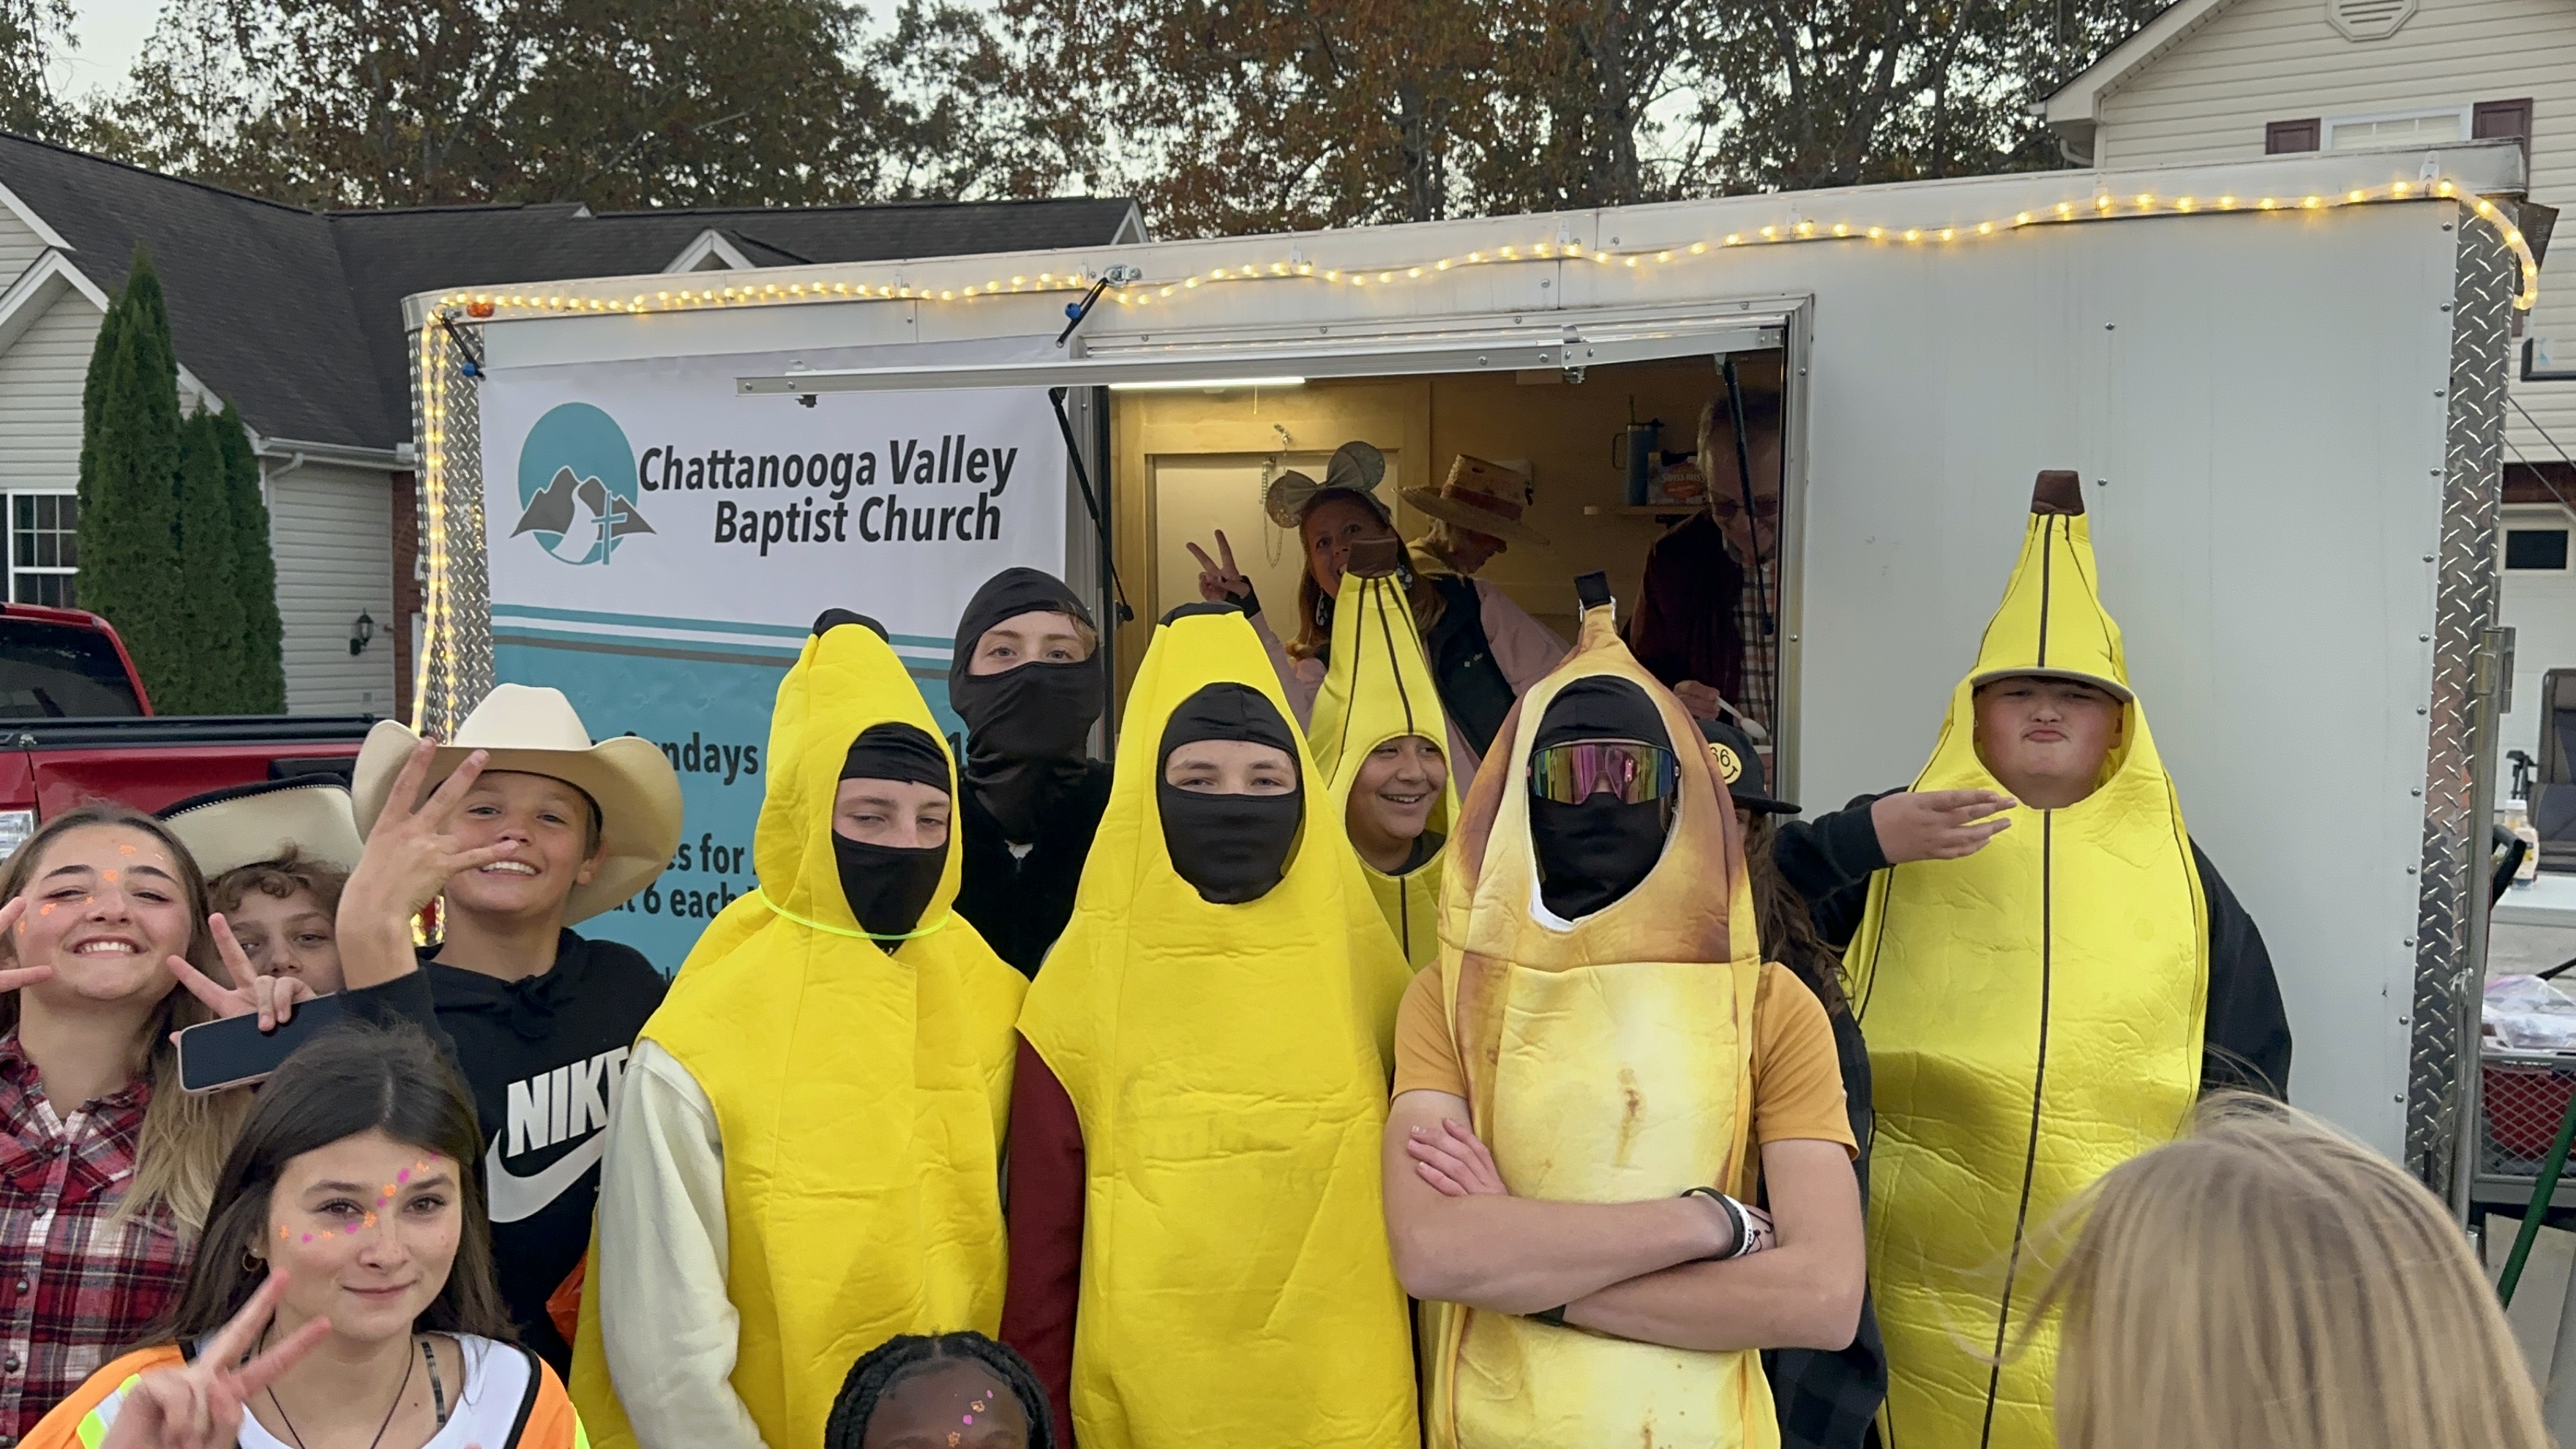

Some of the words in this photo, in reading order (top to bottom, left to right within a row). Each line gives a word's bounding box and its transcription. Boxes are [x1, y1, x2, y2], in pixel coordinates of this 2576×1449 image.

[640, 445, 876, 501] Chattanooga
[889, 434, 1019, 497] Valley
[714, 496, 848, 556] Baptist
[859, 492, 1000, 542] Church
[624, 731, 759, 786] ndays
[700, 832, 745, 875] for
[643, 880, 661, 915] 6
[670, 882, 737, 918] each
